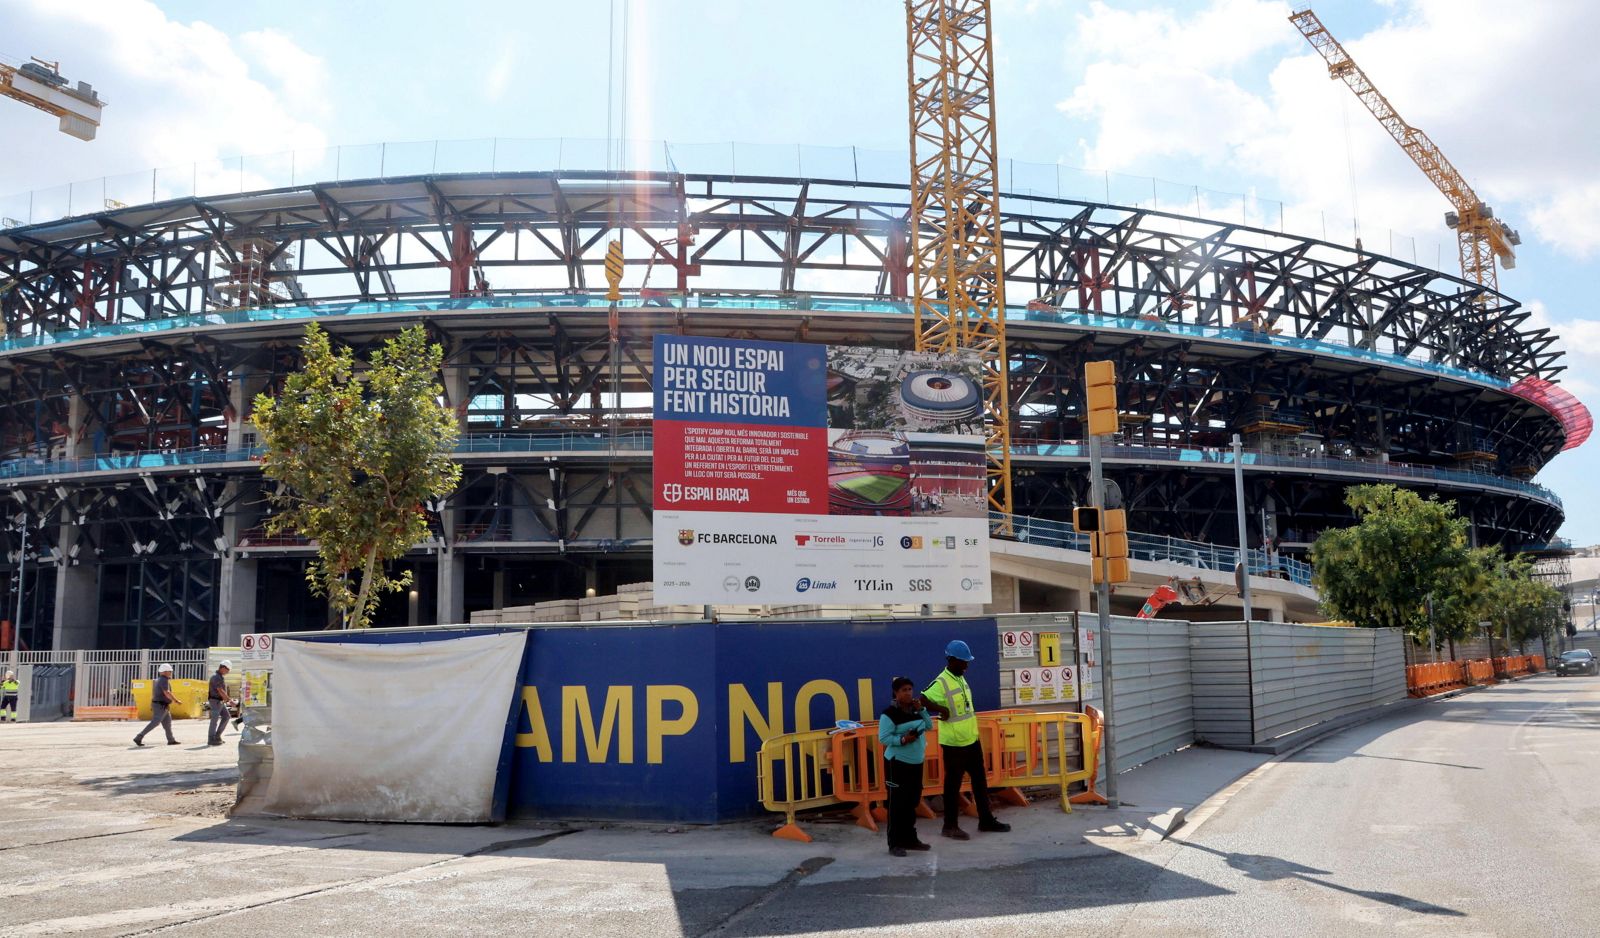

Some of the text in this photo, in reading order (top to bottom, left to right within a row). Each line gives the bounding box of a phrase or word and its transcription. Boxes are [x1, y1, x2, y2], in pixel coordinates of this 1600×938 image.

[664, 343, 784, 372] UN NOU ESPAI
[664, 366, 766, 393] PER SEGUIR
[664, 390, 790, 418] FENT HISTÒRIA
[780, 432, 808, 440] SOSTENIBLE
[759, 446, 772, 455] SERÀ
[781, 448, 799, 456] IMPULS
[684, 486, 750, 504] ESPAI BARÇA
[698, 533, 777, 544] FC BARCELONA
[813, 535, 846, 544] Torrella
[873, 536, 884, 548] JG
[812, 580, 837, 590] Limak
[909, 579, 932, 592] SGS
[1046, 646, 1055, 662] 1
[515, 678, 899, 764] AMP NO
